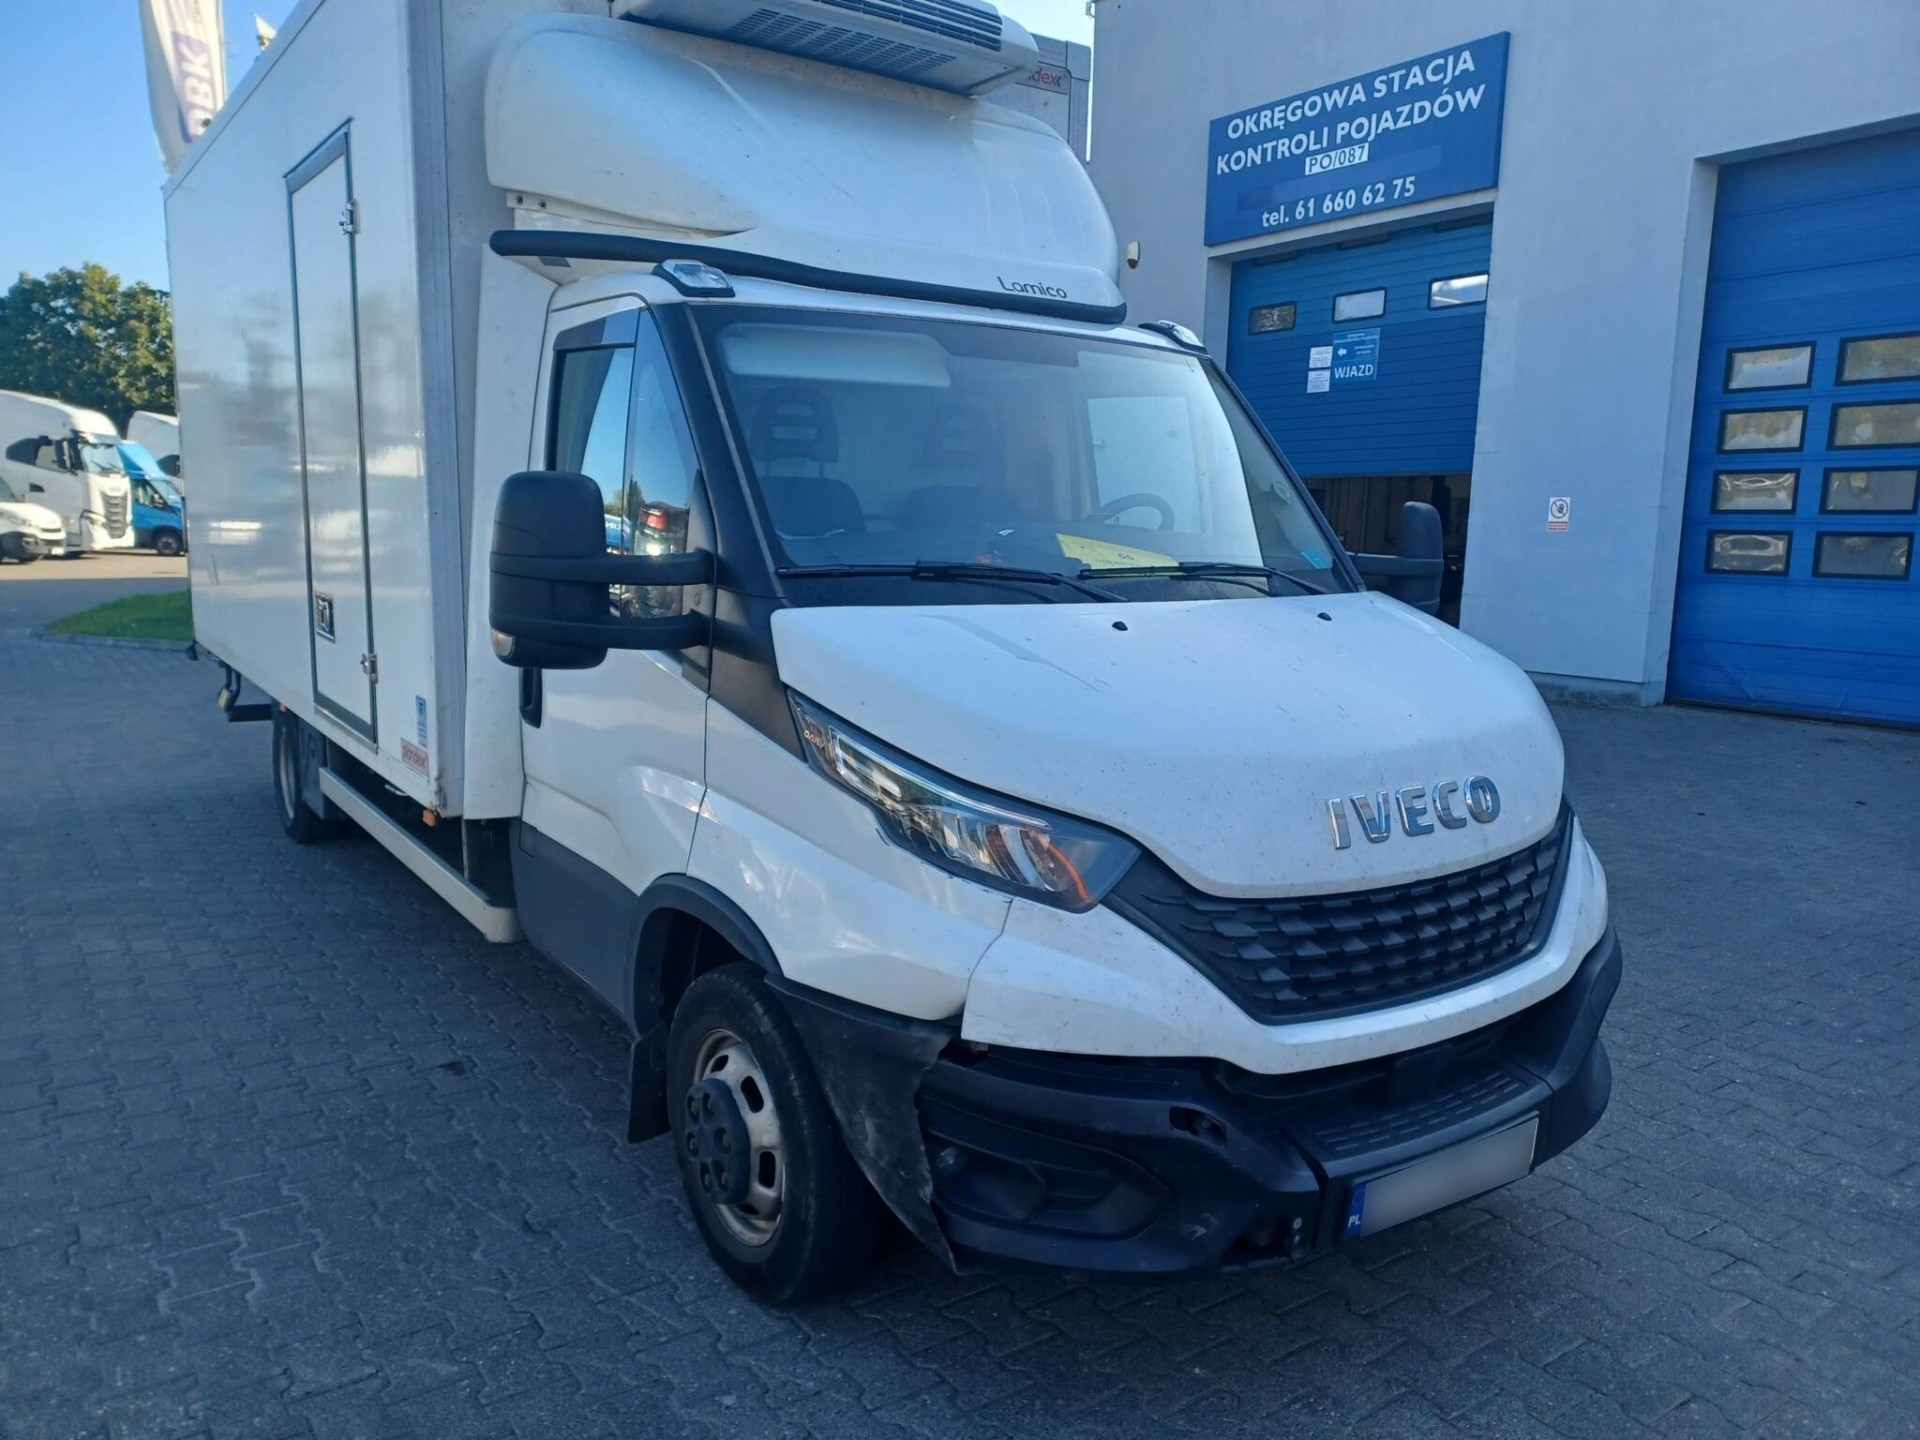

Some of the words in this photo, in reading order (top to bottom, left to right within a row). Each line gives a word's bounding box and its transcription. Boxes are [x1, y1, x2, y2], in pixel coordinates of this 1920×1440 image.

[1227, 82, 1367, 139] OKRĘGOWA
[1373, 50, 1475, 98] STACJA
[1216, 127, 1328, 175] KONTROLI
[1335, 84, 1486, 144] POJAZDÓW
[1308, 145, 1367, 173] PO/087
[1262, 205, 1289, 227] tel.
[1295, 198, 1315, 220] 61
[1322, 189, 1355, 214] 660
[1362, 182, 1385, 207] 62
[1393, 176, 1415, 199] 75
[997, 275, 1067, 299] Lamico
[1334, 364, 1374, 379] WJAZD
[1325, 775, 1501, 850] IVECO
[1347, 1214, 1361, 1227] PL
